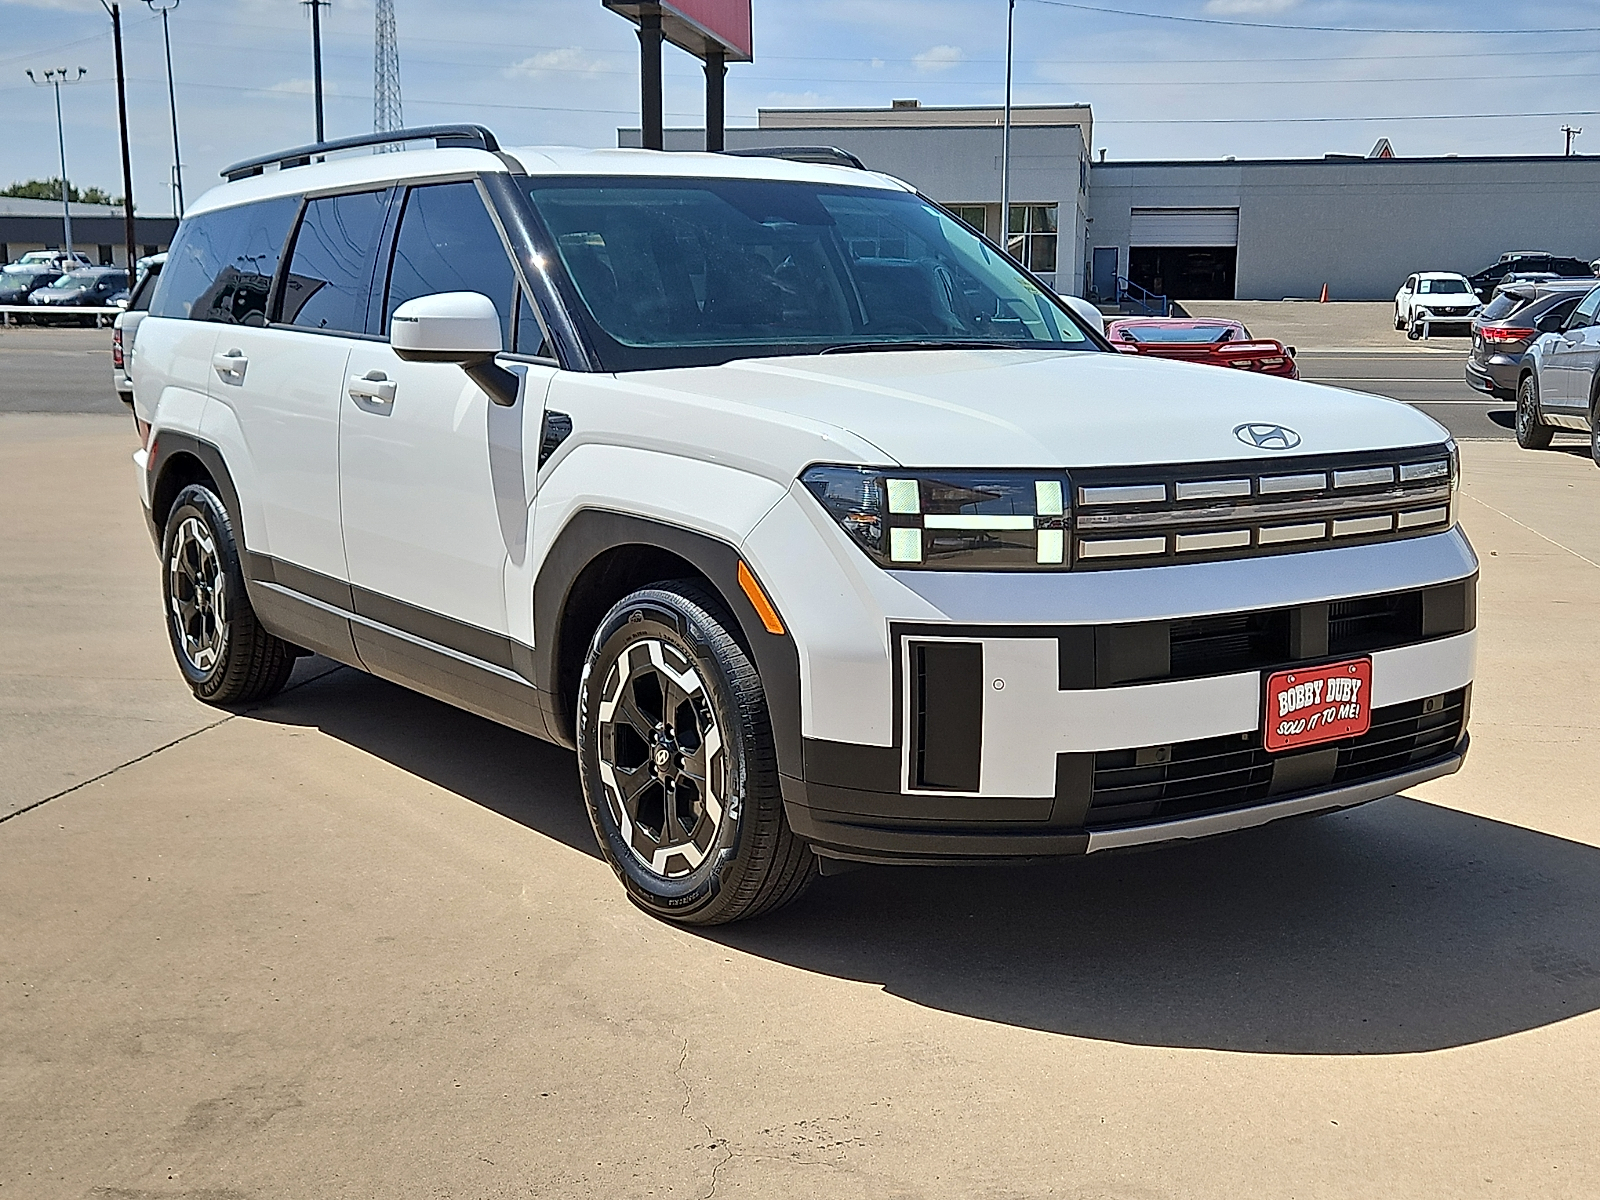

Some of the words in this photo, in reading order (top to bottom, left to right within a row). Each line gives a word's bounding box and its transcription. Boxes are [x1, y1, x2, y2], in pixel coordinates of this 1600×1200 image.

[1277, 680, 1324, 717] BOBBY
[1326, 677, 1362, 703] DUBY
[1276, 719, 1306, 735] SOLD
[1306, 713, 1321, 731] IT
[1320, 707, 1336, 726] TO
[1337, 702, 1361, 719] ME!
